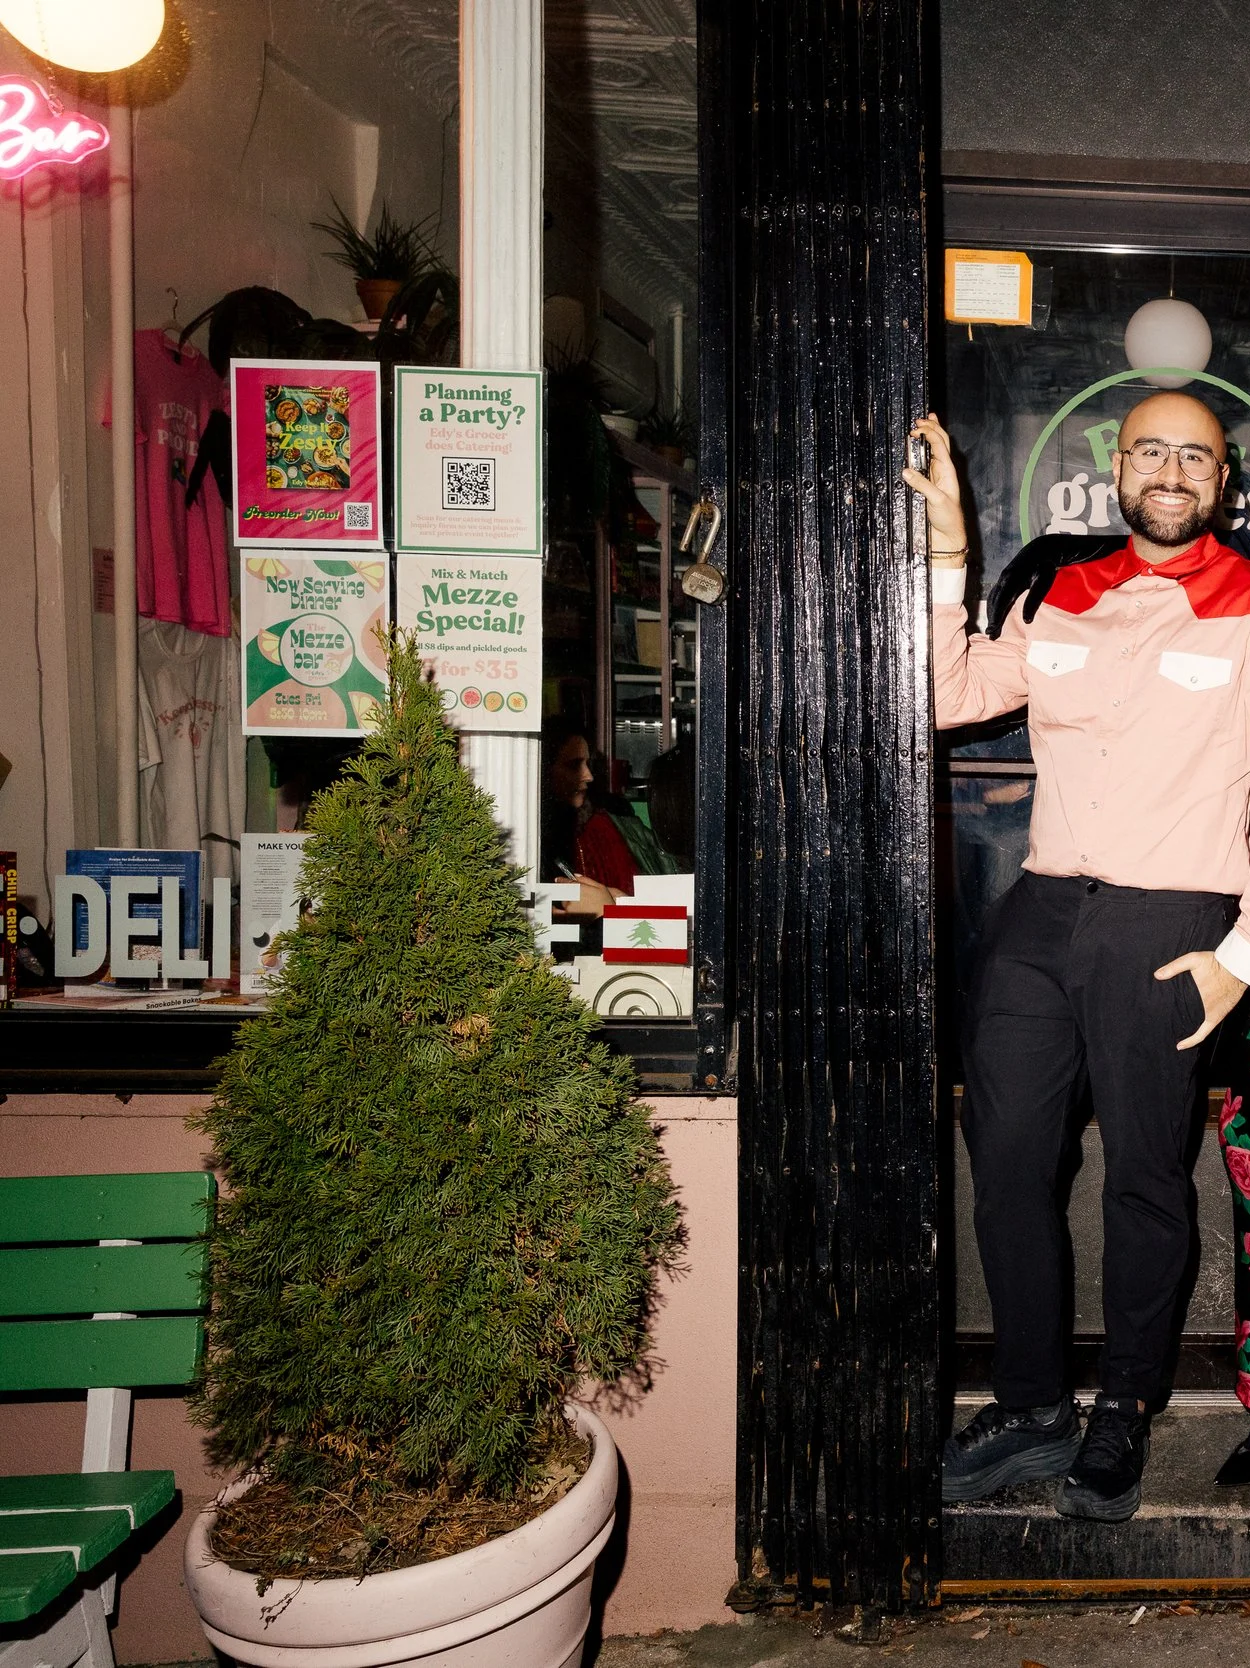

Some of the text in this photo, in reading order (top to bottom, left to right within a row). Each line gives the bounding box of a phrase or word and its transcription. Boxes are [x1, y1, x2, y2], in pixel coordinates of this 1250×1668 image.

[0, 84, 100, 168] Bar
[424, 383, 512, 406] Planning
[419, 403, 526, 430] a Party?
[286, 422, 329, 435] Keep It
[430, 427, 507, 440] Edy's Grocer
[279, 433, 338, 455] Zesty
[425, 440, 513, 455] does Catering!
[243, 505, 340, 523] Preorder Now!
[431, 568, 508, 580] Mix & Match
[266, 575, 365, 598] Now Serving
[422, 583, 518, 608] Mezze
[290, 592, 342, 610] Dinner
[306, 623, 326, 632] The
[416, 609, 525, 636] Special!
[290, 629, 345, 649] Mezze
[436, 643, 454, 652] dips
[472, 644, 502, 653] pickled
[503, 646, 527, 654] goods
[293, 649, 324, 670] bar
[441, 660, 470, 677] for
[475, 659, 518, 680] $35
[6, 869, 17, 902] CHILI
[6, 908, 17, 944] CRISP
[54, 875, 231, 978] DELI
[146, 999, 182, 1009] Snackable
